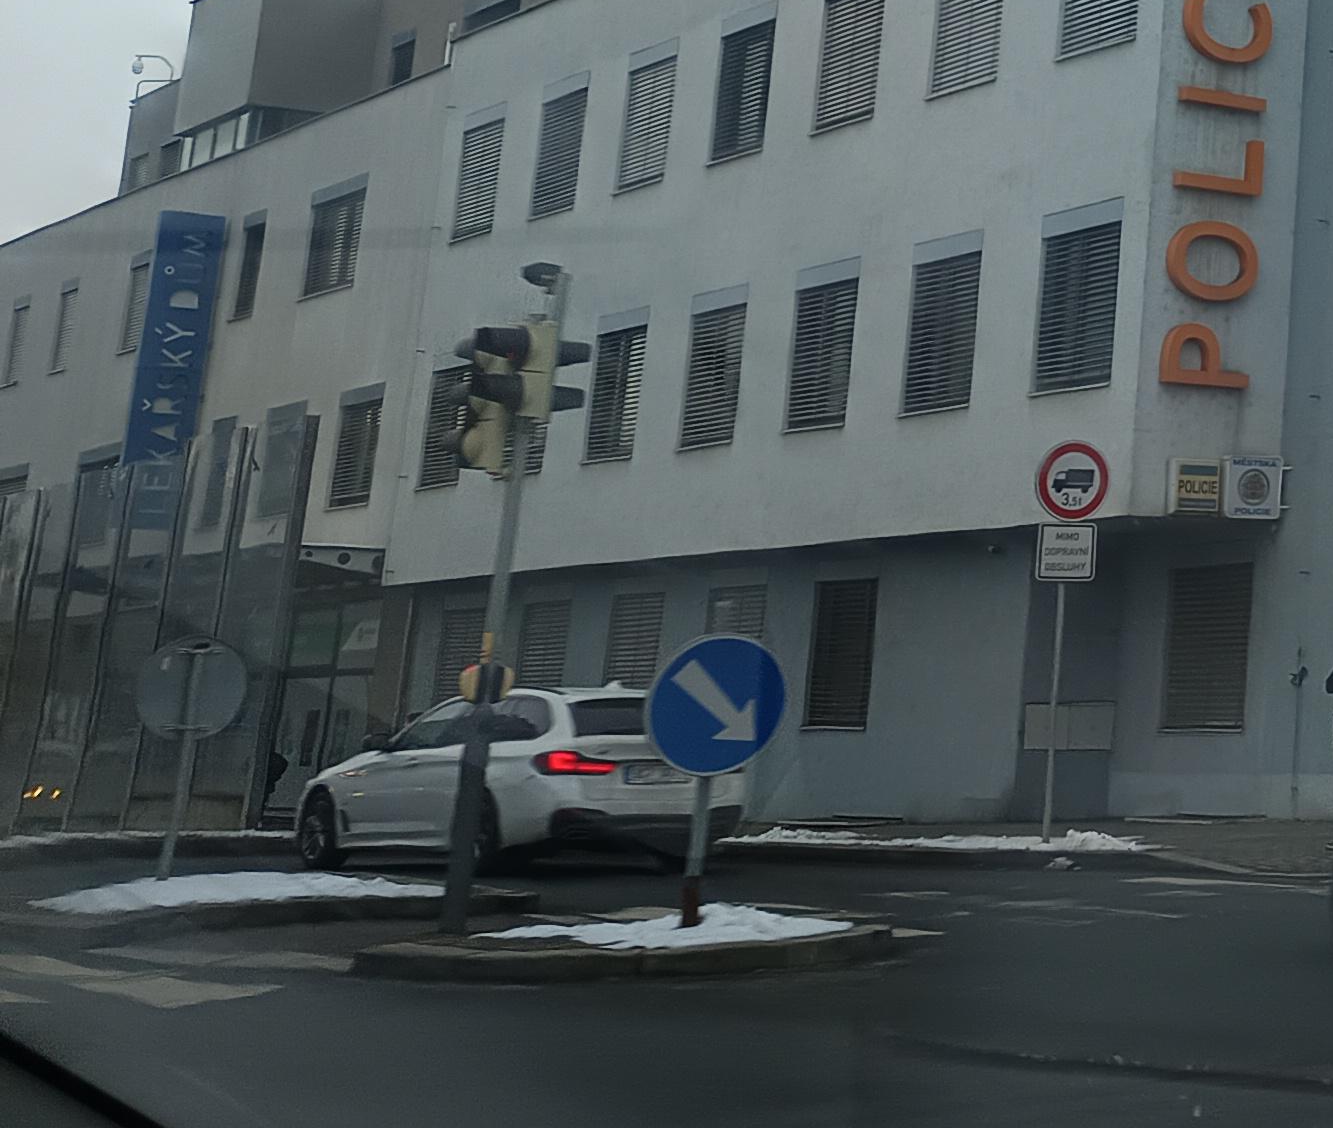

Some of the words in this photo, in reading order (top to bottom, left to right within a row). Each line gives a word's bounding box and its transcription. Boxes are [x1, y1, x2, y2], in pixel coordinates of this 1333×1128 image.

[164, 233, 209, 310] DŮM
[1178, 479, 1218, 495] POLICIE
[1234, 507, 1272, 515] POLICIE
[1055, 532, 1080, 541] MIMO
[1044, 546, 1089, 556] DOPRAVNÍ
[1044, 562, 1087, 572] OBSLUHY
